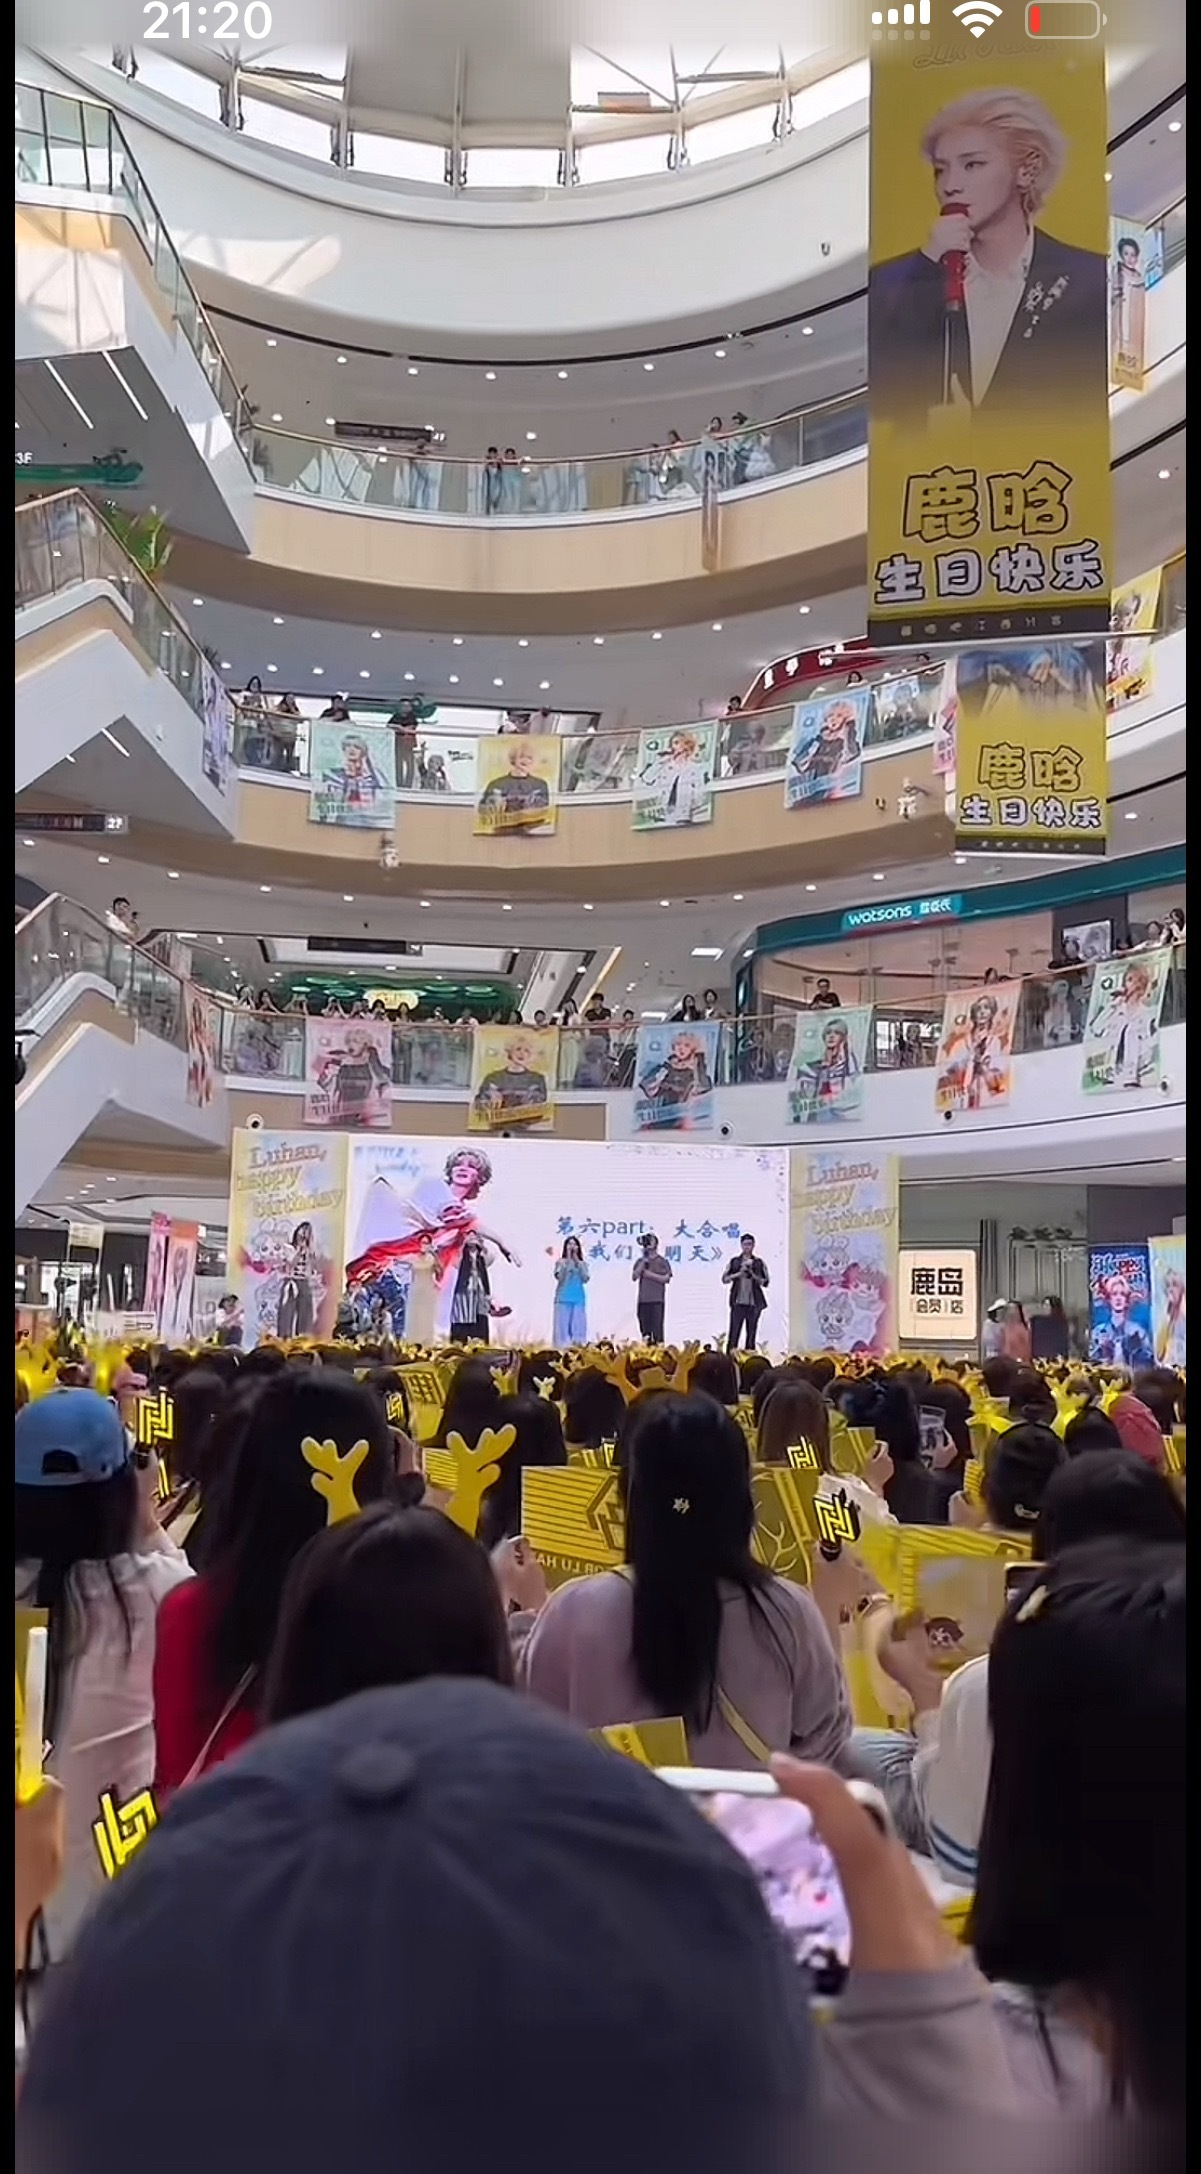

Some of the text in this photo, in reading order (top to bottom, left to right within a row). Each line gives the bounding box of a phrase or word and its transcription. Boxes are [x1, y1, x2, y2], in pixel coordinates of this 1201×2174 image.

[903, 460, 1072, 543] 鹿晗
[874, 538, 1103, 604] 生日快乐
[978, 742, 1083, 792] 鹿晗
[960, 793, 1101, 828] 生日快乐
[848, 905, 912, 925] watsons
[911, 1267, 963, 1296] 鹿岛
